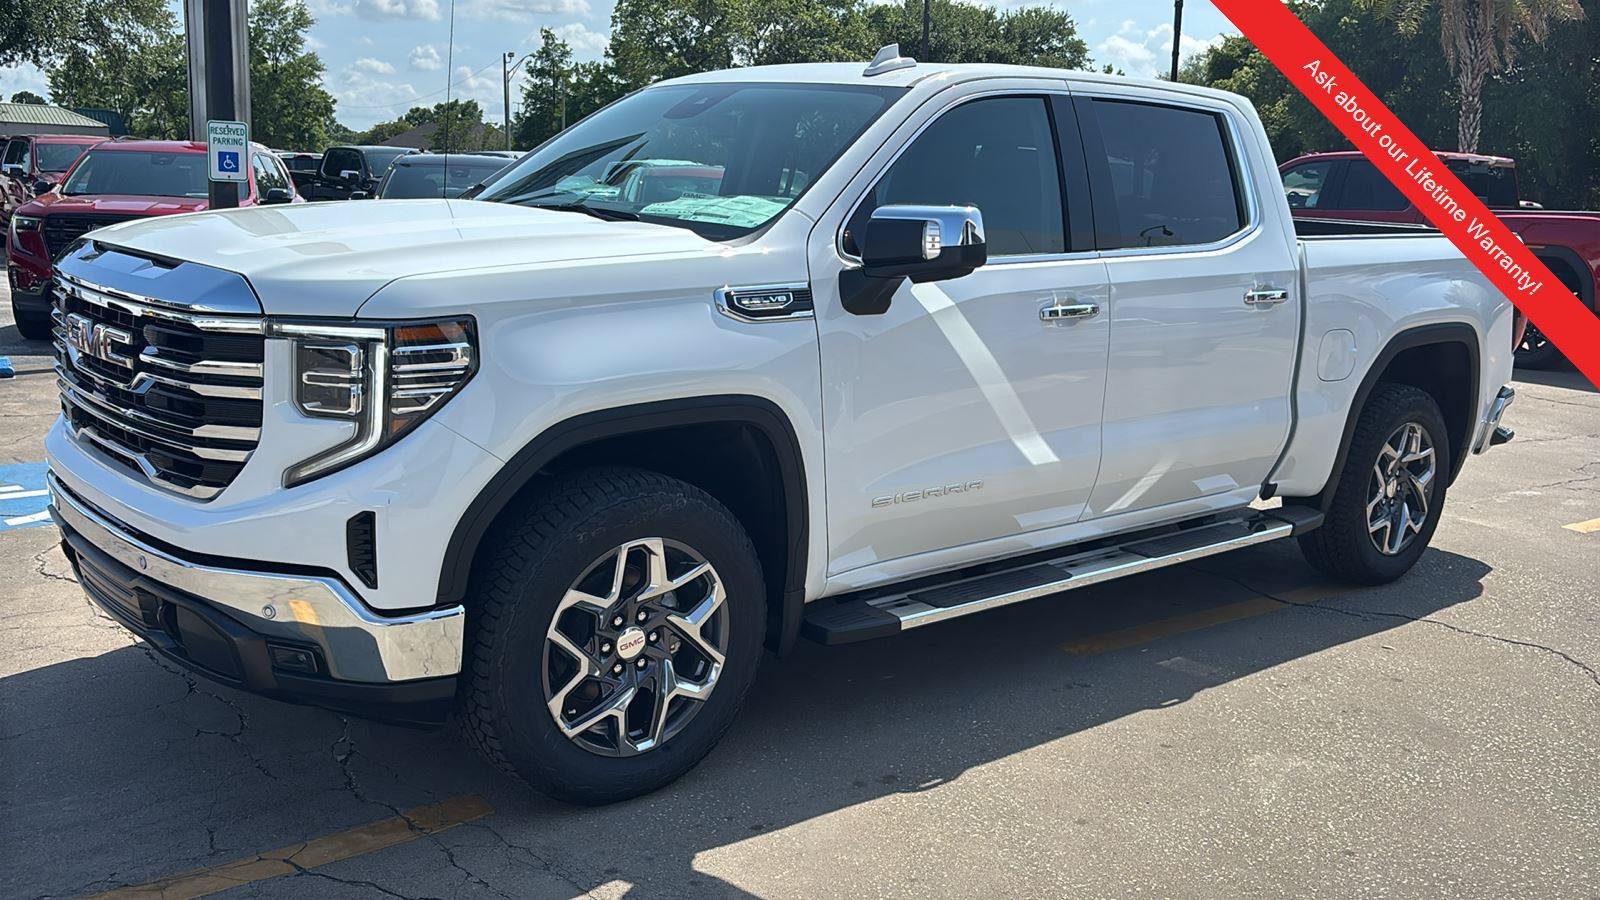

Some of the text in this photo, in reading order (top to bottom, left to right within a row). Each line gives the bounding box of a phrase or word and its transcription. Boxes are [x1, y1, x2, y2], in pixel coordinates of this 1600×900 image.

[210, 126, 245, 136] RESERVED
[212, 137, 244, 146] PARKING
[66, 312, 134, 370] GMC
[871, 479, 984, 509] SIERRA
[619, 635, 644, 651] GMC
